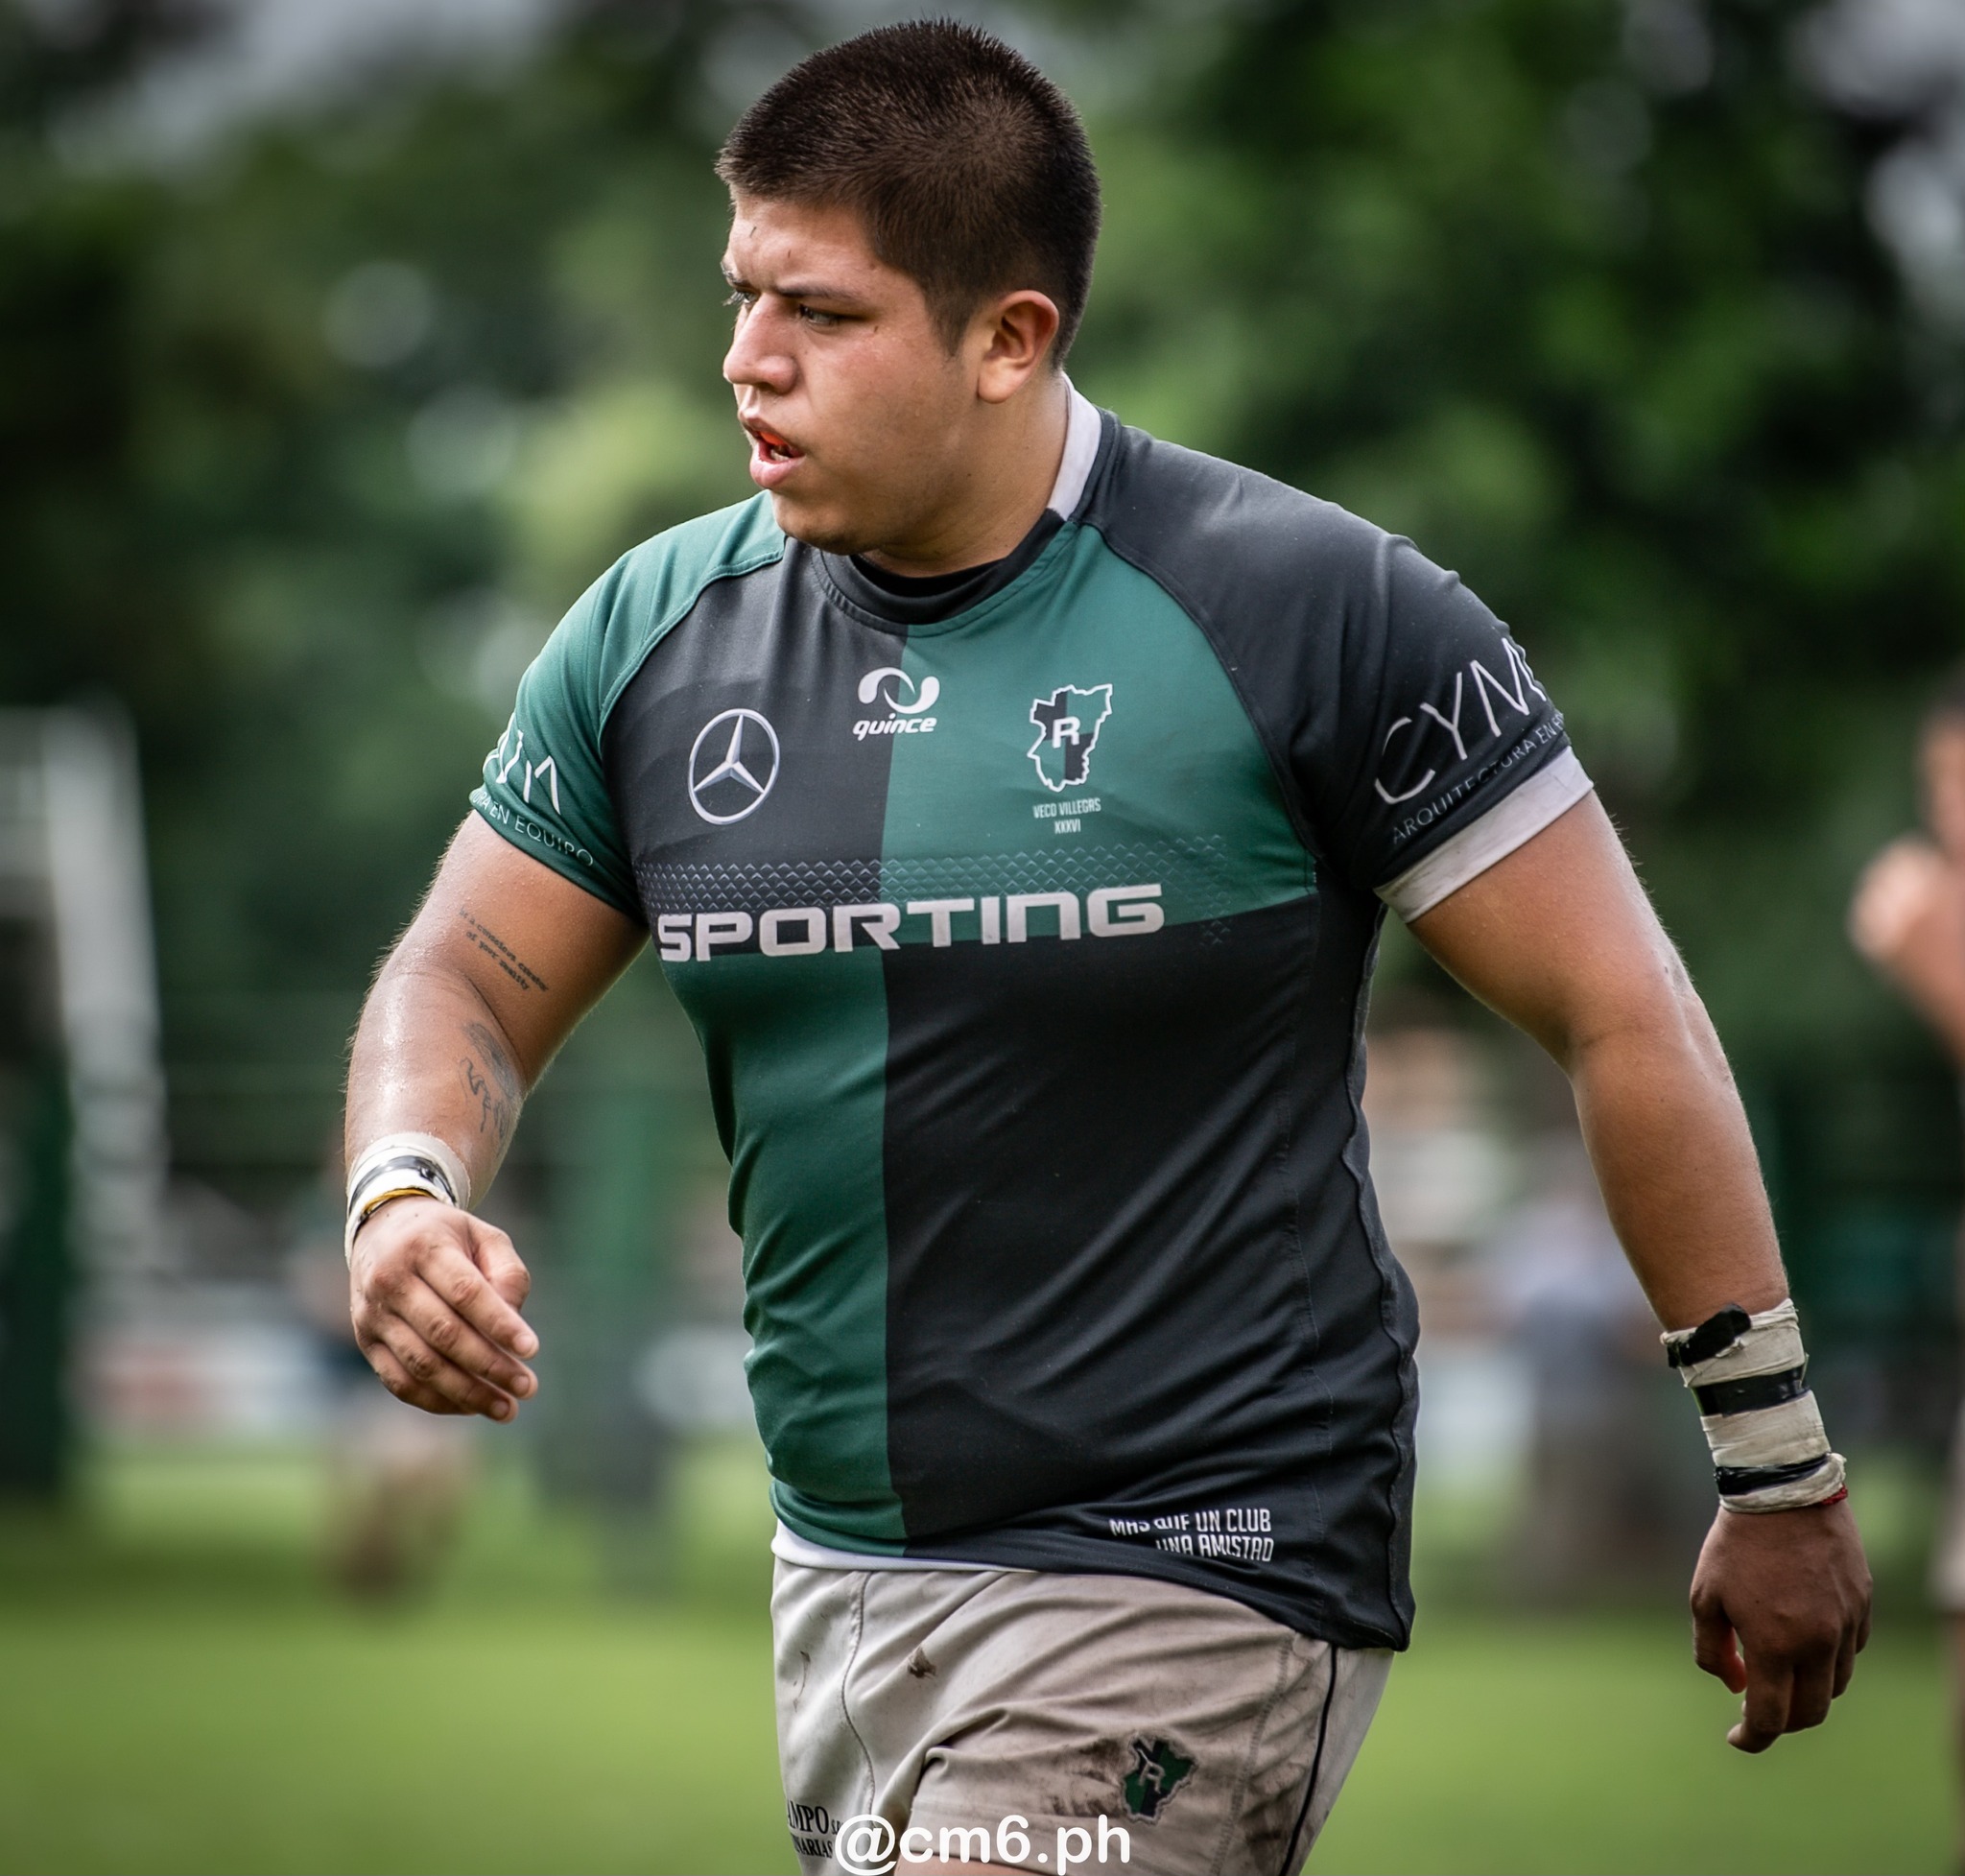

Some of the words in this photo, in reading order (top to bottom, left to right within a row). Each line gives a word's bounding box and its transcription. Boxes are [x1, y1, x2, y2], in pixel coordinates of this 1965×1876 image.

[852, 712, 937, 742] quince
[1052, 716, 1081, 748] R
[514, 816, 594, 867] EQUIPO
[657, 883, 1165, 962] SPORTING
[1195, 1509, 1220, 1532] UN
[1225, 1508, 1271, 1532] CLUB
[1199, 1534, 1274, 1561] AMISTAD
